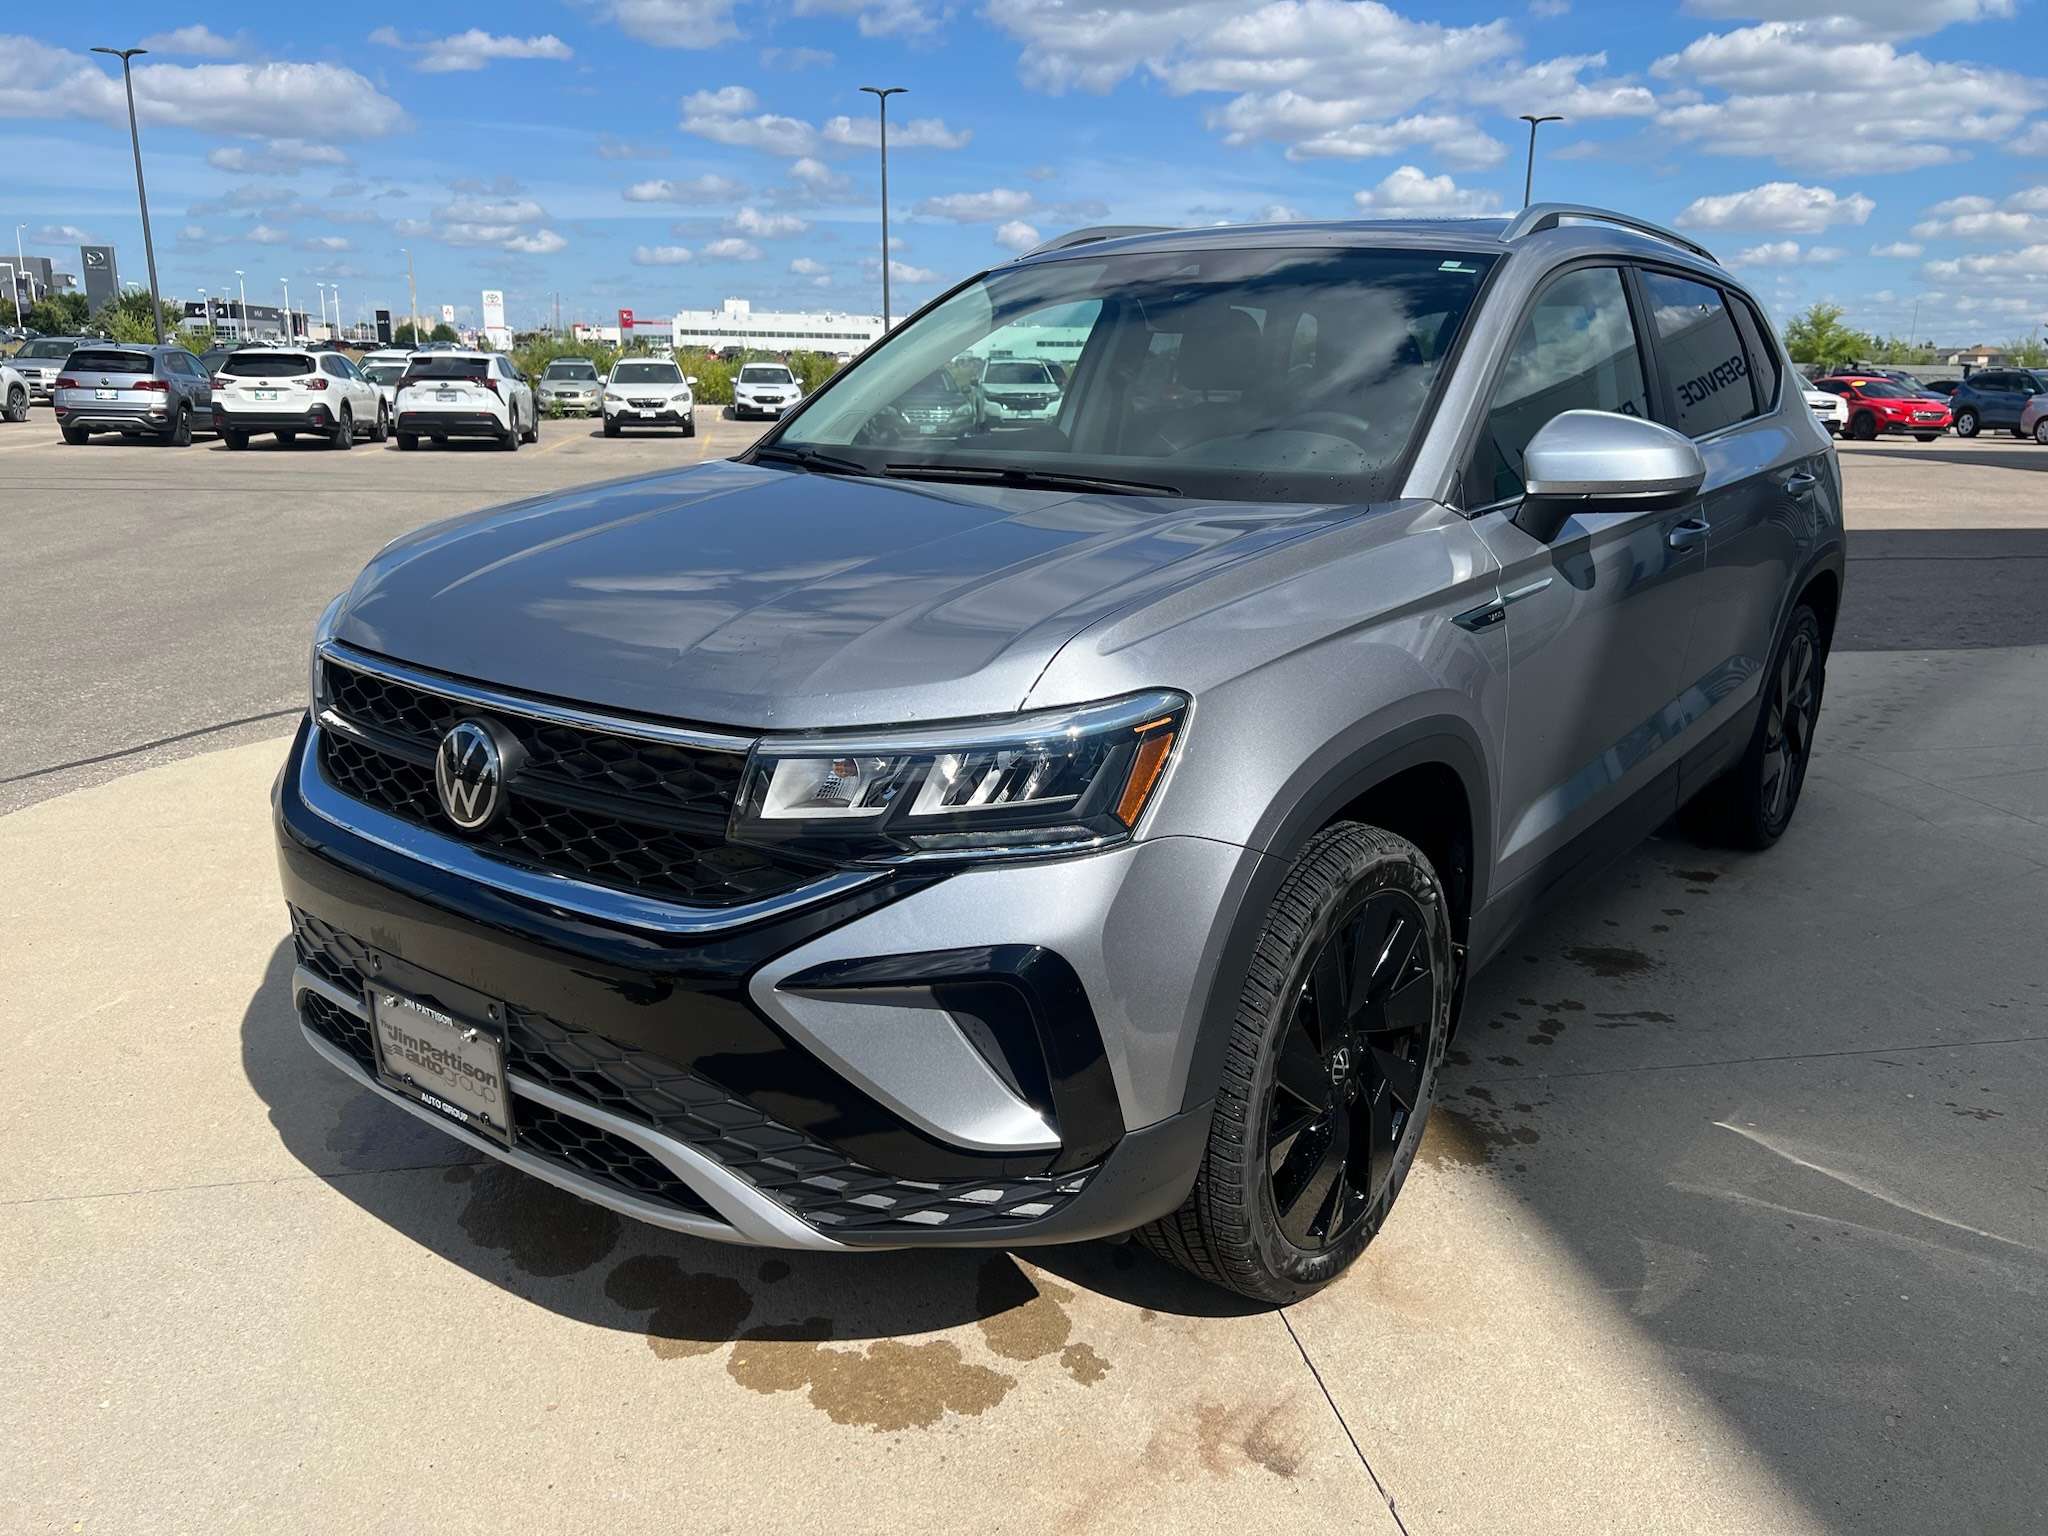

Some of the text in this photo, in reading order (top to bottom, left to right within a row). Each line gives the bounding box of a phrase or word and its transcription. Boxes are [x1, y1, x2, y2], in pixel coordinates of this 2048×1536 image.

[416, 1003, 453, 1027] PATTISON
[421, 1092, 469, 1122] AUTO GROUP
